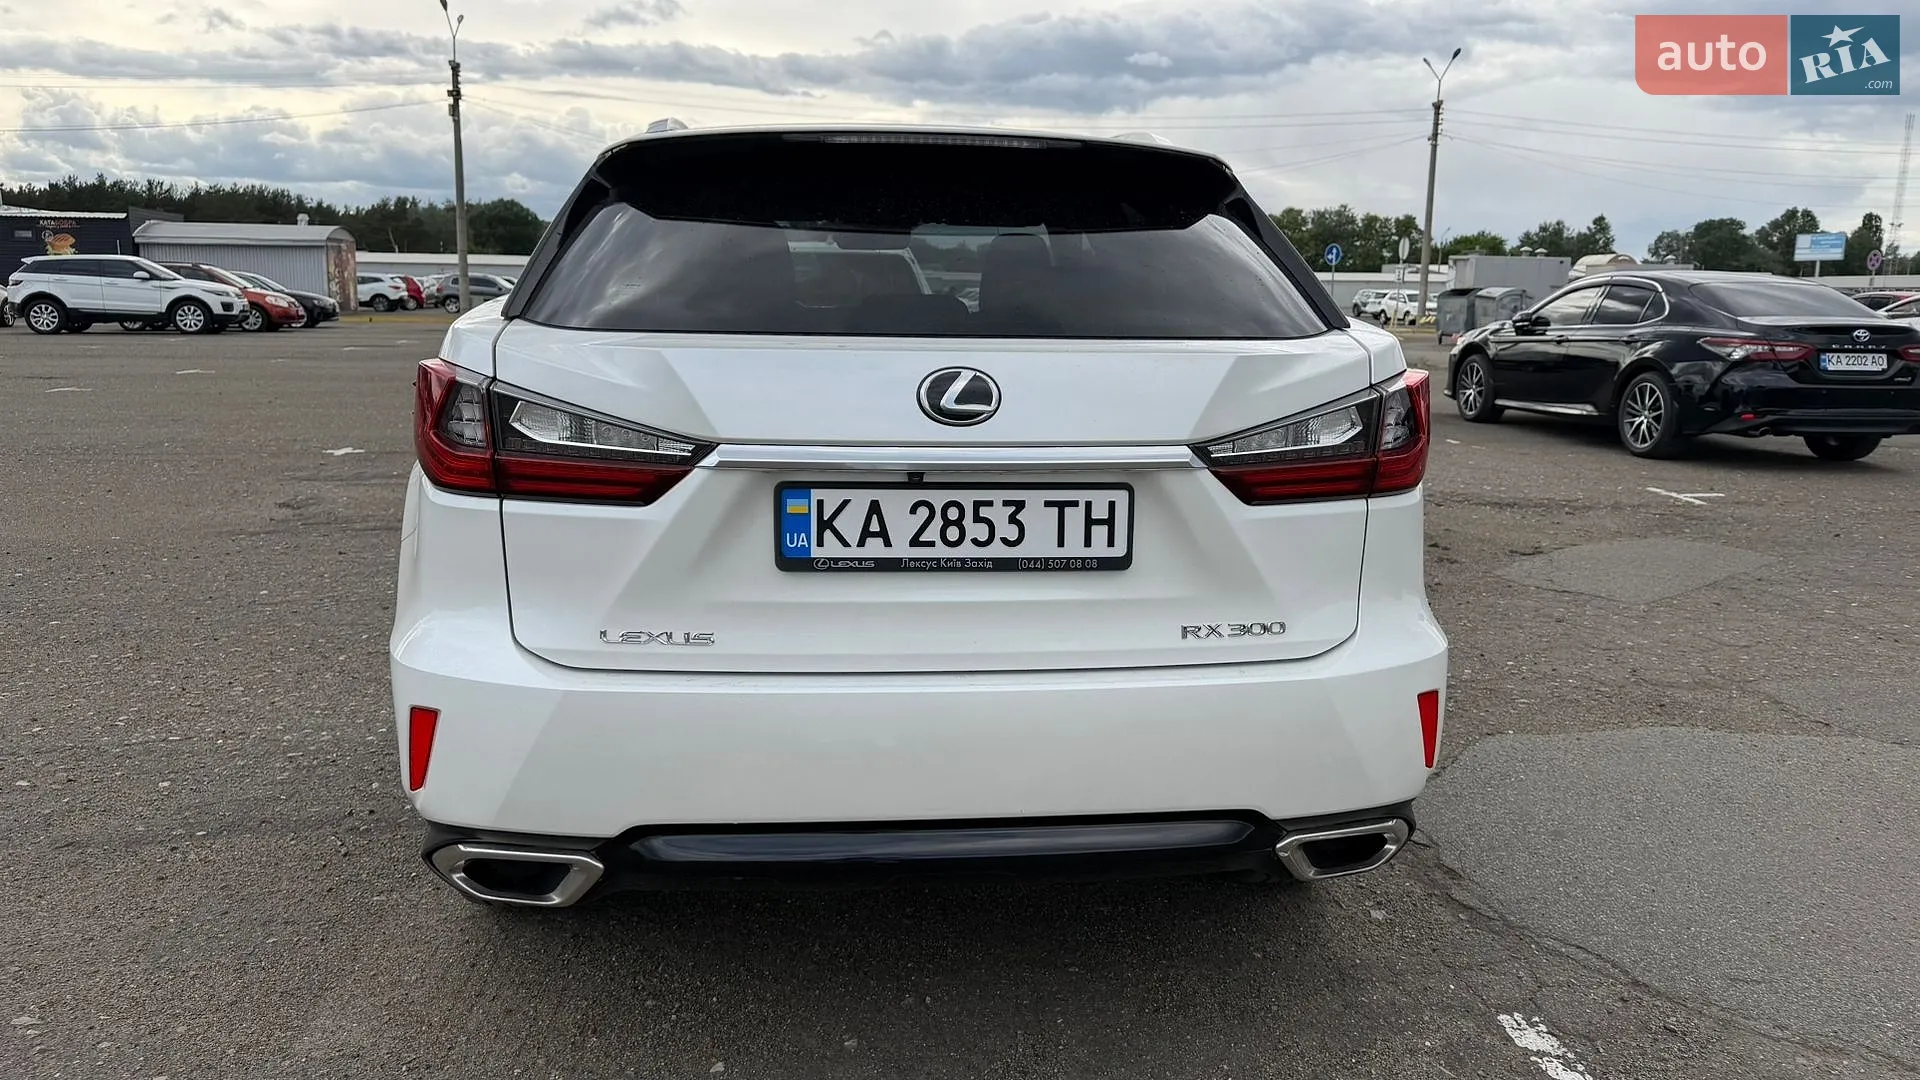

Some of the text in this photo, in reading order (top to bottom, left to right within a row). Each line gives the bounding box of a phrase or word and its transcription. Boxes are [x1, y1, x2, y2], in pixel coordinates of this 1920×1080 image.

[1827, 354, 1843, 367] KA
[1845, 354, 1869, 367] 2202
[816, 498, 1116, 548] KA 2853 TH
[786, 532, 809, 548] UA
[830, 560, 876, 568] LEXUS
[900, 558, 993, 571] Лексус Київ Захід
[1018, 558, 1098, 570] (044) 507 08 08
[600, 629, 715, 646] LEXUS
[1181, 621, 1287, 640] RX 300
